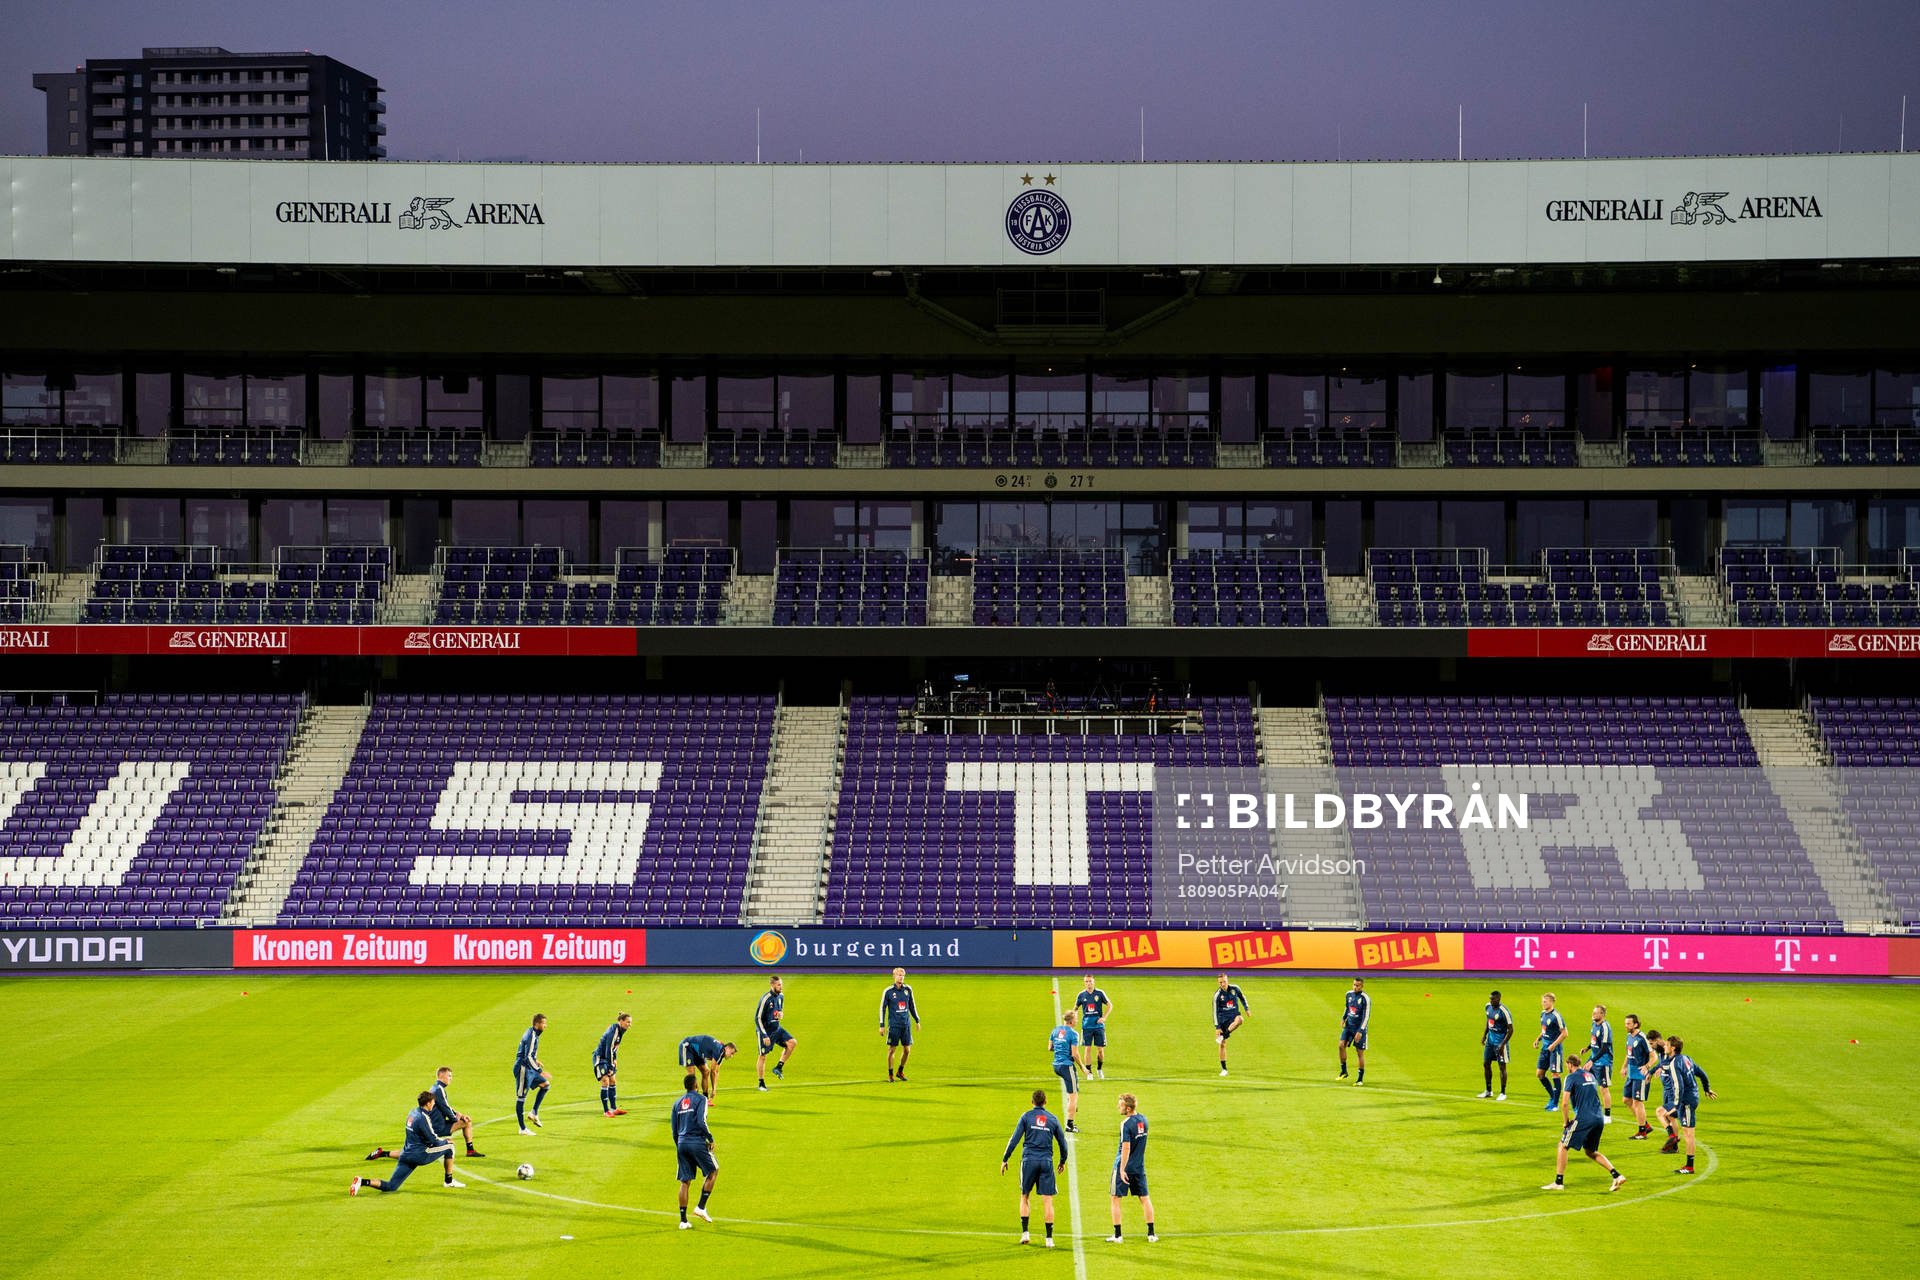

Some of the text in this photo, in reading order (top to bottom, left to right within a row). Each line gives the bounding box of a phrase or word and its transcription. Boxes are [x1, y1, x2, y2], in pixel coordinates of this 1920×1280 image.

[275, 201, 545, 225] GENERALI ARENA
[1014, 194, 1063, 214] FUSSBALLKLUB
[1546, 195, 1823, 222] GENERALI ARENA
[1015, 232, 1062, 250] AUSTRIA WIEN
[1011, 475, 1025, 487] 24
[1070, 475, 1083, 487] 27
[198, 631, 287, 648] GENERALI
[432, 632, 520, 649] GENERALI
[1616, 634, 1707, 651] GENERALI
[2, 937, 143, 962] YUNDAI
[252, 933, 427, 964] Kronen Zeitung
[453, 933, 626, 964] Kronen Zeitung
[795, 938, 960, 957] burgenland
[1082, 934, 1154, 964] BILLA
[1215, 935, 1287, 965] BILLA
[1361, 936, 1434, 966] BILLA
